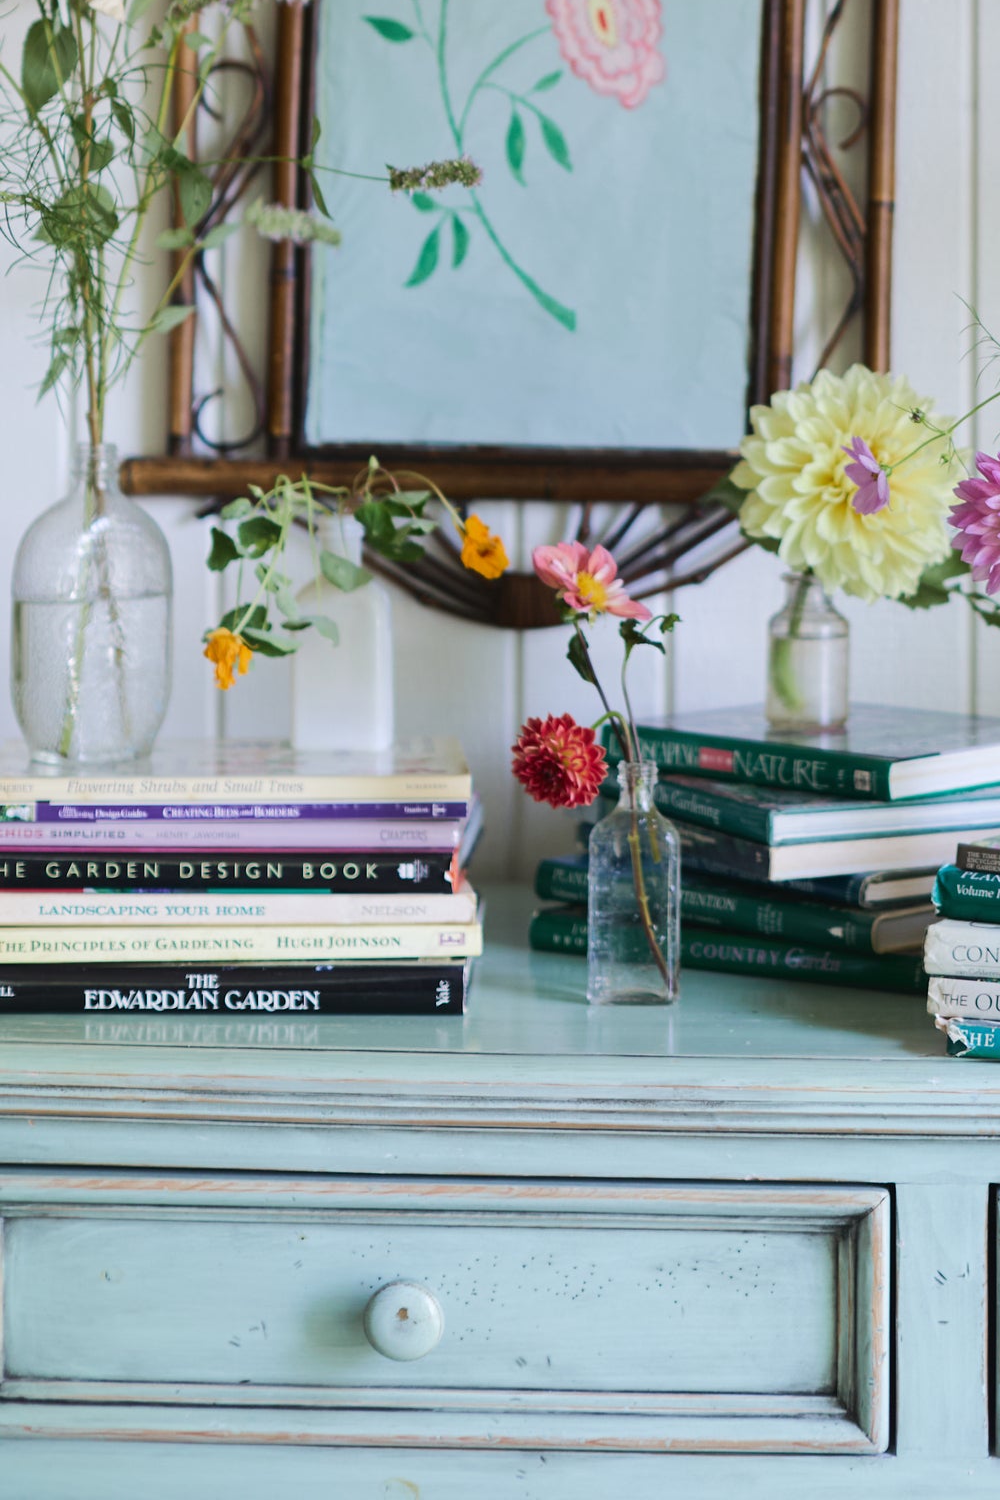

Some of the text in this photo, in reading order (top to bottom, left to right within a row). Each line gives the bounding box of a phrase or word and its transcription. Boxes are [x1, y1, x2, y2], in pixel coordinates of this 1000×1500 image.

[733, 750, 829, 790] NATURE
[66, 779, 304, 794] Flowering Shrubs and Small Trees
[162, 806, 213, 819] CREATING
[214, 807, 240, 819] BEDS
[254, 806, 300, 819] BORDERS
[50, 830, 126, 839] SIMPLIFIED
[380, 829, 428, 842] CHAPTERS
[0, 861, 379, 879] HE GARDEN DESIGN BOOK
[956, 883, 995, 899] Volume
[39, 905, 266, 916] LANDSCAPING YOUR HOME
[361, 905, 427, 916] NELSON
[30, 939, 126, 953] PRINCIPLES
[131, 940, 151, 951] OF
[155, 937, 254, 951] GARDENING
[277, 936, 401, 950] HUGH JOHNSON
[689, 942, 780, 966] COUNTRY
[185, 973, 220, 989] THE
[84, 989, 321, 1011] EDWARDIAN GARDEN
[436, 979, 450, 1007] Yale
[943, 993, 968, 1007] THE
